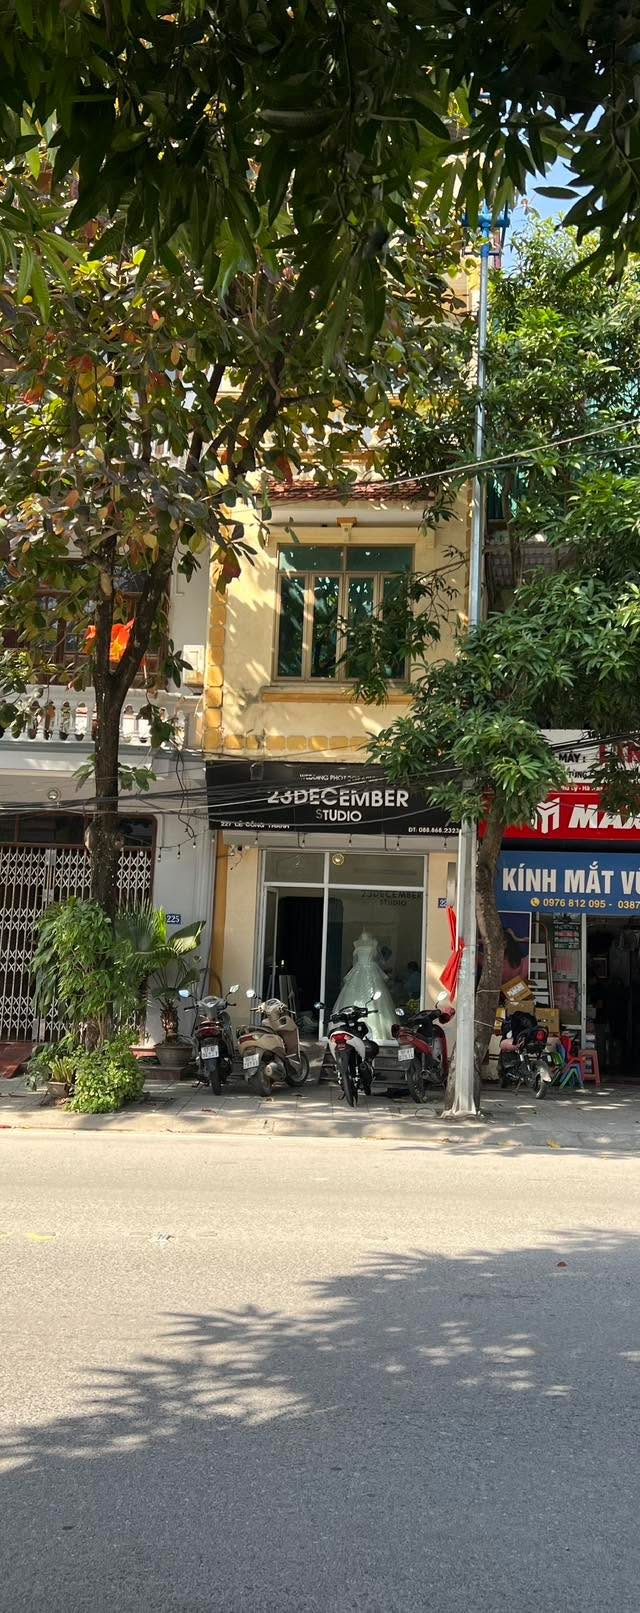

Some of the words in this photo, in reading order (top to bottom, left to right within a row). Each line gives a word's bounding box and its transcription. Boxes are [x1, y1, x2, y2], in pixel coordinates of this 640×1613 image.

[267, 788, 409, 808] 23DECEMBER
[315, 808, 363, 822] STUDIO
[502, 863, 557, 893] KÍNH
[564, 860, 614, 894] MẮT
[543, 898, 565, 907] 0976
[568, 899, 586, 908] 812
[588, 900, 606, 908] 095
[166, 915, 180, 924] 225
